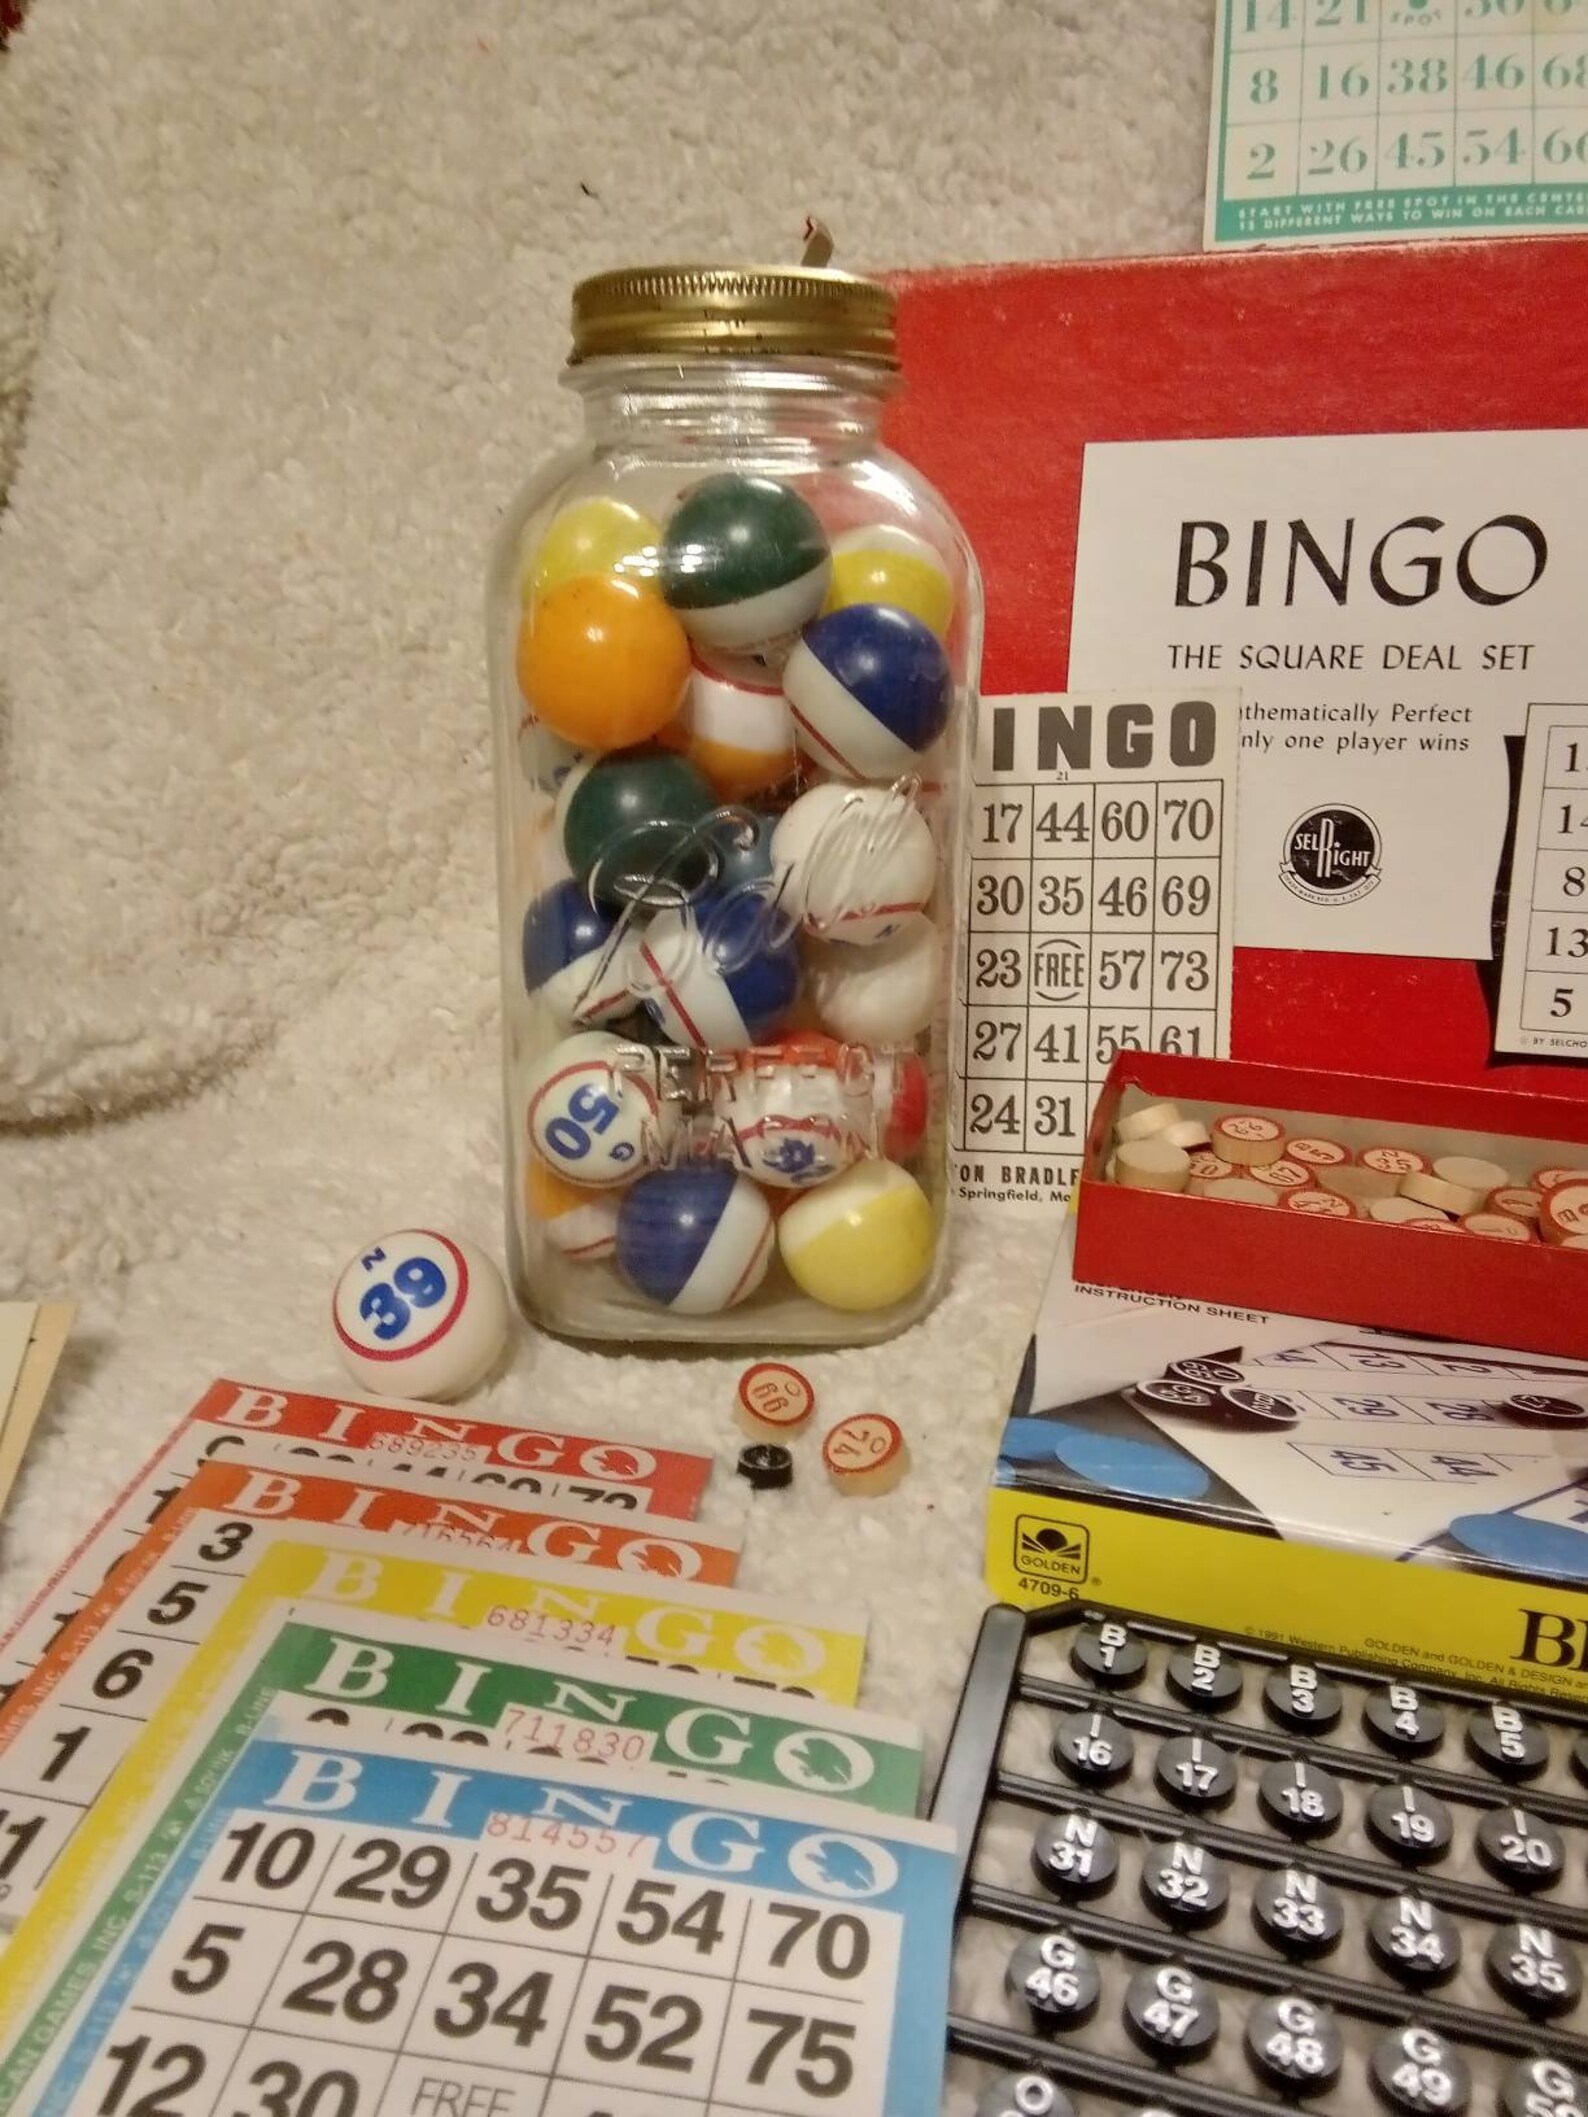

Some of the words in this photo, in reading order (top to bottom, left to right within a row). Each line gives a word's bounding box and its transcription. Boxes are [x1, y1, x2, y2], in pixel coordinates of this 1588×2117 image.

[1250, 68, 1279, 104] 8
[1319, 63, 1369, 100] 16
[1388, 58, 1447, 95] 38
[1463, 53, 1525, 90] 46
[1246, 143, 1276, 180] 2
[1307, 137, 1368, 177] 26
[1384, 131, 1445, 169] 45
[1463, 127, 1525, 166] 54
[1264, 214, 1343, 230] DIFFERENT
[1350, 211, 1394, 223] WAYS
[1402, 209, 1422, 221] TO
[1431, 208, 1463, 219] WIN
[1471, 206, 1496, 218] ON
[1505, 205, 1545, 217] EACH
[1301, 201, 1346, 215] WITH
[1174, 514, 1548, 607] BINGO
[1167, 645, 1223, 670] THE
[1240, 644, 1364, 670] SQUARE
[1383, 645, 1463, 670] DEAL
[1481, 645, 1535, 670] SET
[1238, 702, 1380, 726] thematically
[1391, 702, 1473, 724] Perfect
[992, 700, 1217, 772] INGO
[1284, 734, 1325, 750] one
[1337, 730, 1407, 755] player
[1420, 731, 1470, 752] wins
[1055, 770, 1069, 781] 21
[982, 803, 1023, 844] 17
[1036, 801, 1090, 843] 44
[1101, 800, 1149, 842] 60
[1163, 798, 1214, 841] 70
[976, 875, 1024, 916] 30
[1038, 875, 1084, 916] 35
[1098, 876, 1147, 917] 46
[1162, 875, 1211, 917] 69
[1562, 866, 1587, 897] 8
[976, 949, 1022, 988] 23
[1034, 953, 1084, 987] FREE
[1099, 950, 1146, 991] 57
[1160, 950, 1209, 991] 73
[1549, 988, 1575, 1018] 5
[973, 1021, 1021, 1062] 27
[1034, 1024, 1080, 1063] 41
[1096, 1025, 1142, 1064] 55
[1160, 1025, 1201, 1057] 61
[545, 1083, 620, 1161] 50
[970, 1094, 1021, 1134] 24
[1034, 1096, 1077, 1137] 31
[959, 1186, 1043, 1203] Springfield,
[361, 1246, 387, 1272] N
[360, 1257, 447, 1340] 39
[1075, 1284, 1200, 1312] INSTRUCTION
[1206, 1306, 1270, 1324] SHEET
[217, 1387, 656, 1480] BINGO
[198, 1521, 253, 1562] 3
[223, 1470, 702, 1580] BINGO
[1021, 1555, 1081, 1575] GOLDEN
[147, 1581, 210, 1625] 5
[1018, 1577, 1080, 1600] 4709-6
[306, 1552, 825, 1676] BINGO
[487, 1604, 616, 1646] 681334
[1100, 1623, 1127, 1647] B
[93, 1649, 154, 1699] 6
[1100, 1646, 1115, 1669] 1
[1194, 1643, 1220, 1669] B
[1364, 1636, 1420, 1657] GOLDEN
[1422, 1650, 1445, 1662] and
[1448, 1654, 1505, 1674] GOLDEN
[1508, 1665, 1517, 1676] &
[1520, 1667, 1573, 1686] DESIGN
[1191, 1667, 1216, 1692] 2
[1290, 1664, 1317, 1690] B
[304, 1637, 874, 1792] BINGO
[1291, 1688, 1315, 1713] 3
[1390, 1685, 1418, 1711] B
[504, 1708, 645, 1761] 711830
[1395, 1712, 1420, 1736] 4
[1492, 1705, 1523, 1733] B
[40, 1725, 92, 1782] 1
[1073, 1736, 1112, 1766] 16
[1500, 1731, 1526, 1759] 5
[1176, 1762, 1219, 1791] 17
[1281, 1787, 1325, 1817] 18
[264, 1750, 898, 1899] BINGO
[486, 1812, 648, 1859] 814557
[1065, 1814, 1098, 1847] N
[1391, 1812, 1435, 1843] 19
[1049, 1841, 1094, 1876] 31
[1172, 1842, 1205, 1875] N
[1500, 1835, 1552, 1867] 20
[220, 1822, 315, 1890] 10
[334, 1838, 451, 1909] 29
[476, 1858, 590, 1931] 35
[617, 1879, 725, 1955] 54
[767, 1902, 870, 1981] 70
[1157, 1868, 1210, 1907] 32
[1285, 1869, 1317, 1903] N
[1272, 1897, 1326, 1935] 33
[1400, 1897, 1432, 1931] N
[1041, 1935, 1076, 1970] G
[1391, 1926, 1445, 1964] 34
[1518, 1923, 1554, 1959] N
[1025, 1967, 1079, 2006] 46
[1156, 1967, 1193, 2004] G
[1510, 1953, 1568, 1992] 35
[171, 1923, 247, 1994] 5
[281, 1941, 408, 2025] 28
[434, 1962, 553, 2047] 34
[585, 1984, 703, 2073] 52
[745, 2007, 857, 2098] 75
[1143, 2000, 1200, 2039] 47
[1277, 1999, 1316, 2036] G
[1266, 2030, 1325, 2074] 48
[1402, 2028, 1441, 2066] G
[97, 2035, 207, 2117] 12
[232, 2061, 359, 2117] 30
[412, 2077, 516, 2117] FREE
[1392, 2062, 1451, 2105] 49
[1532, 2060, 1574, 2102] G
